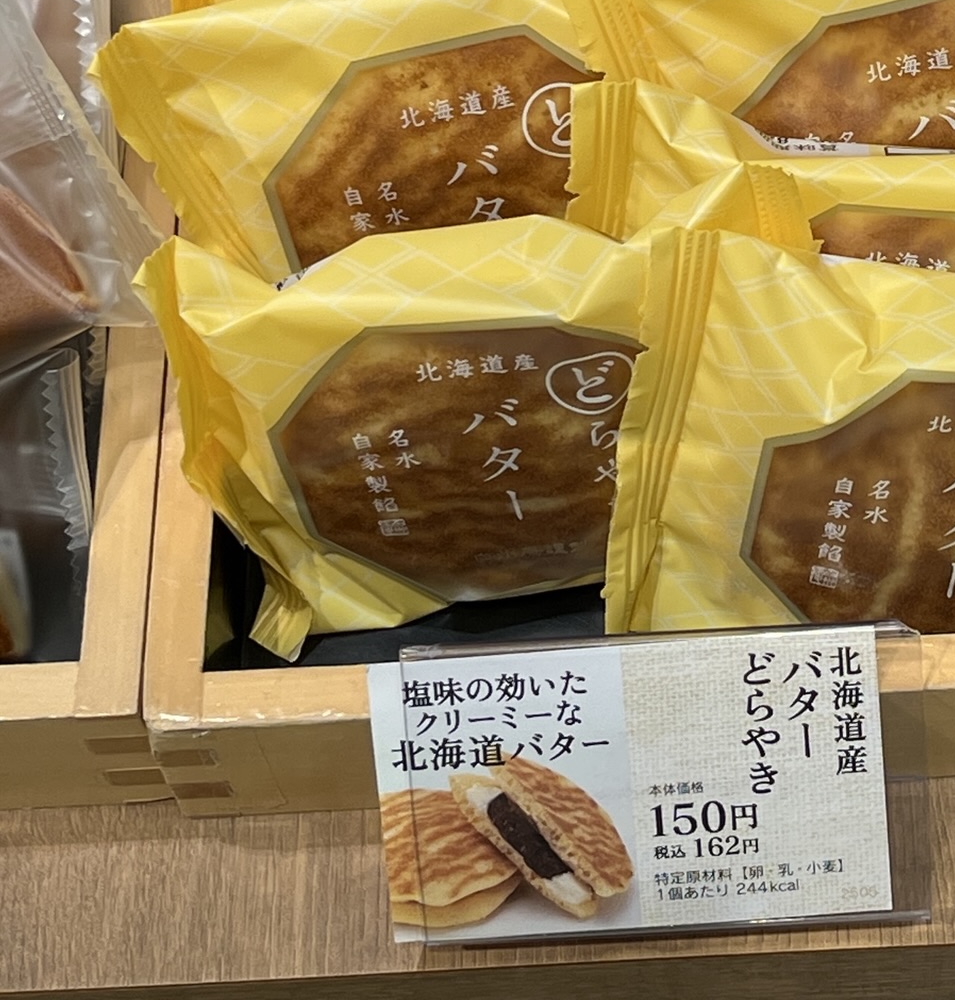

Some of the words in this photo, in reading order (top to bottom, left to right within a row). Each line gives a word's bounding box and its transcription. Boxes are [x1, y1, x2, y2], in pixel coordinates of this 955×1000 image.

[399, 84, 516, 130] 北海道産
[343, 186, 377, 233] 自家
[376, 181, 410, 227] 名水
[415, 353, 540, 384] 北海道産
[387, 428, 422, 470] 名水
[571, 360, 619, 506] どらや
[461, 397, 524, 521] バター
[817, 476, 855, 563] 自家製餡
[862, 479, 892, 524] 名水
[401, 670, 589, 709] 塩味の効いた
[782, 650, 823, 759] バター
[829, 645, 868, 776] 北海道産
[416, 699, 583, 737] クリーミーな
[741, 651, 782, 795] どらやき
[391, 731, 610, 772] 北海道バター
[648, 781, 705, 797] 本体価格
[650, 799, 759, 838] 150円
[653, 844, 687, 860] 税込
[693, 834, 761, 859] 162円
[735, 879, 801, 897] 244kcal
